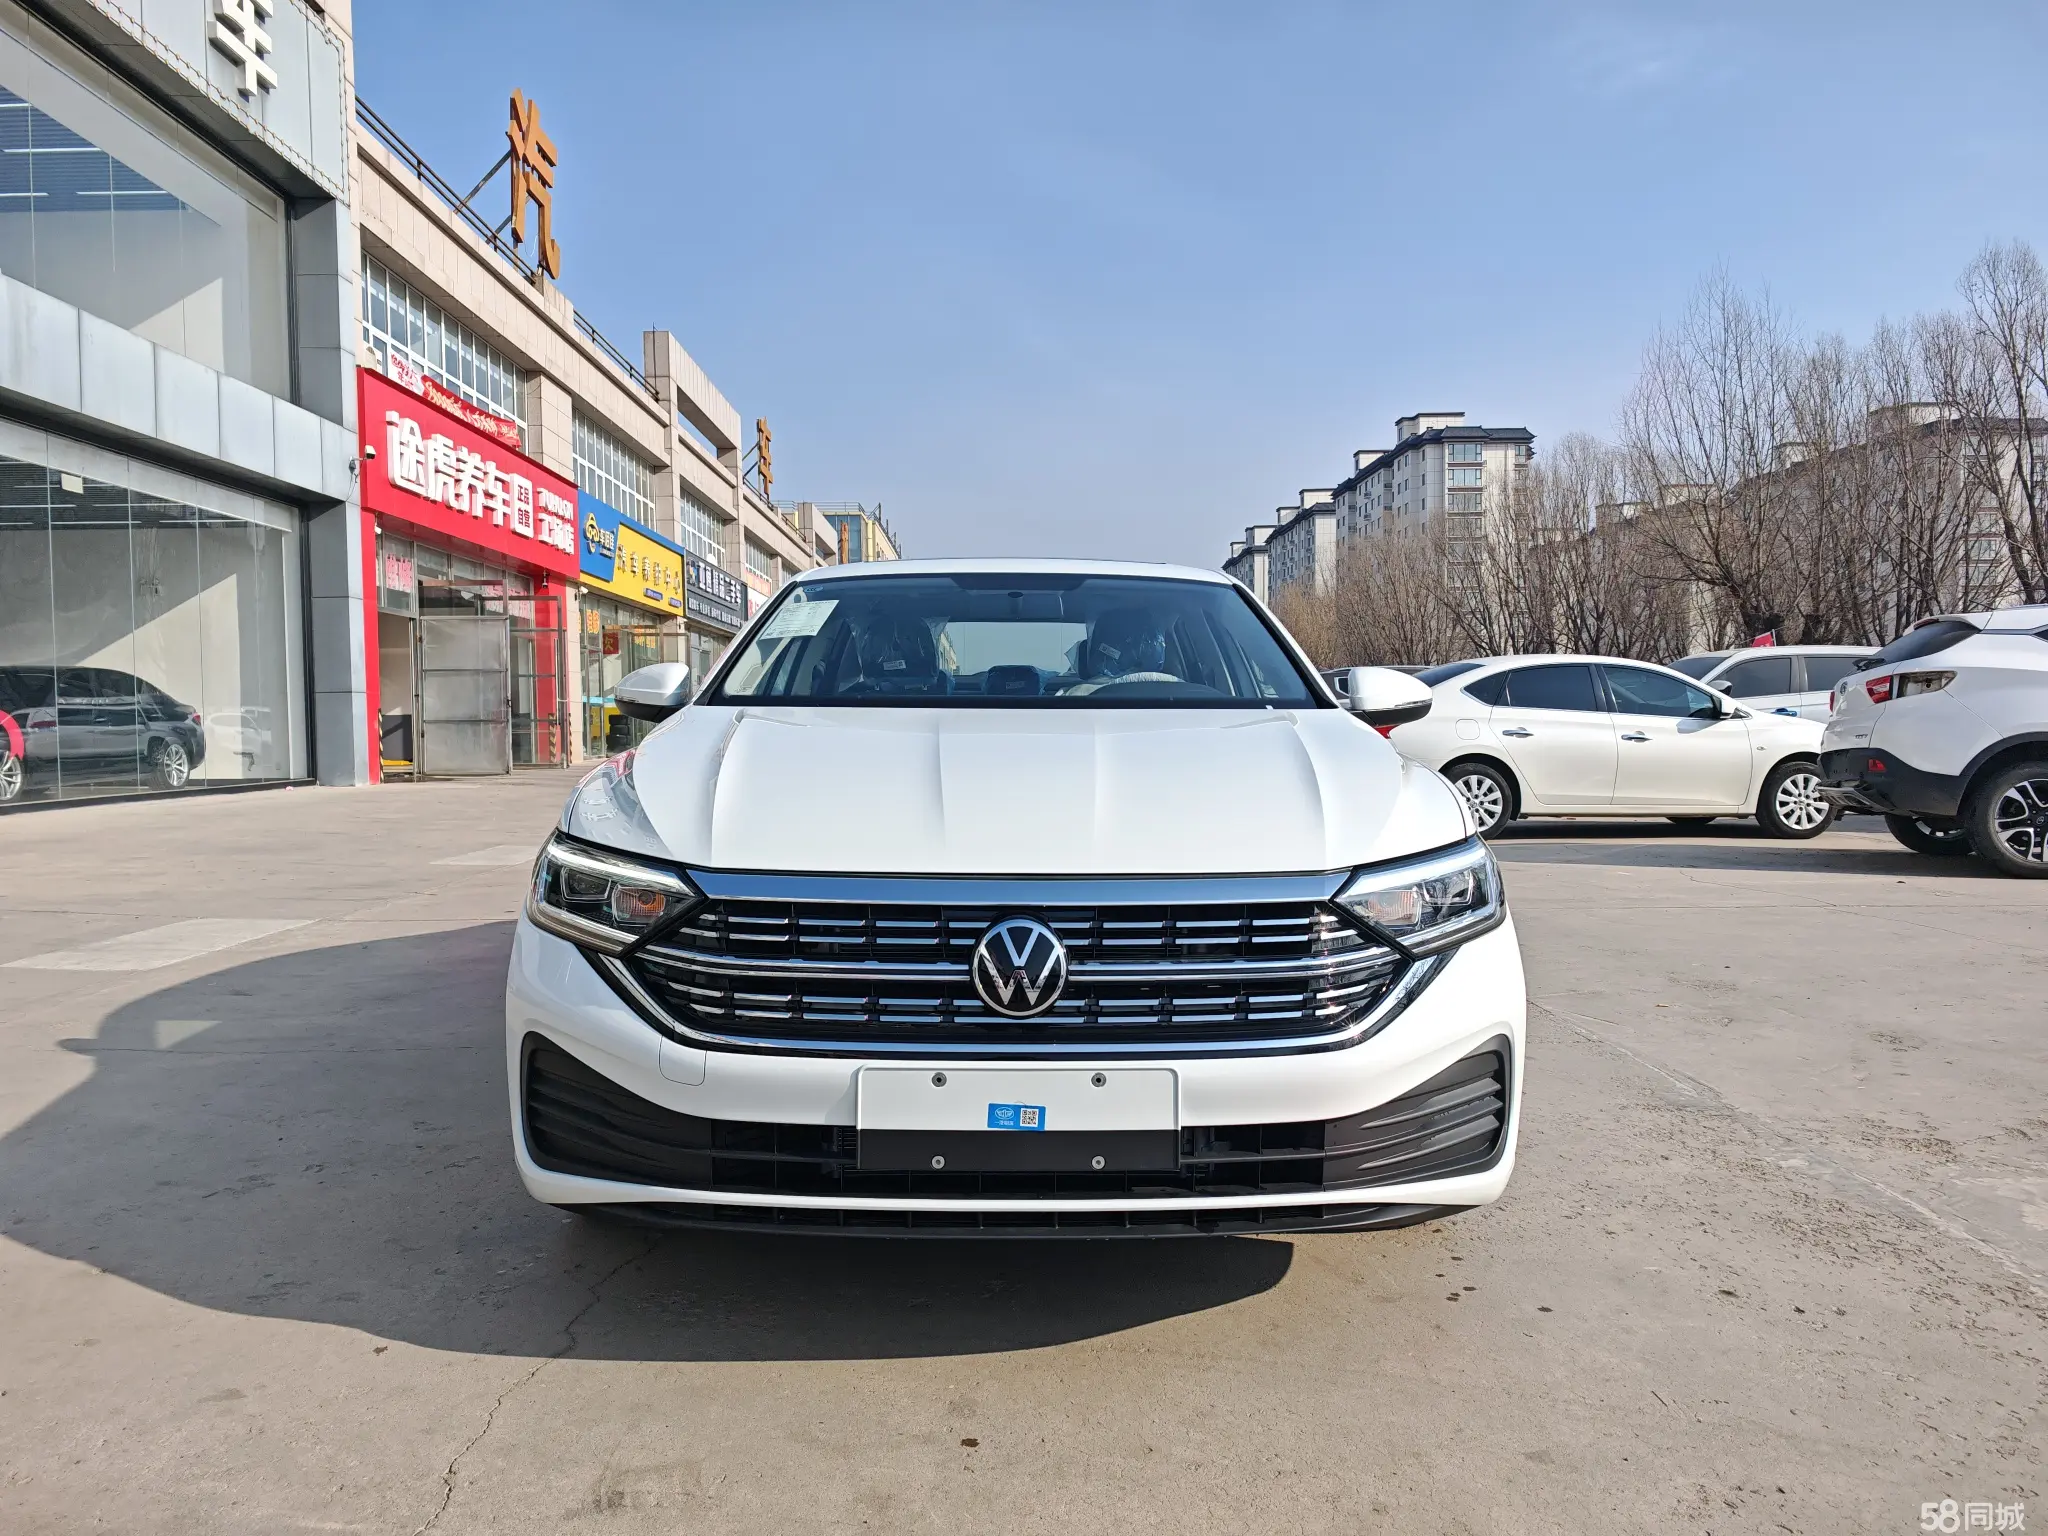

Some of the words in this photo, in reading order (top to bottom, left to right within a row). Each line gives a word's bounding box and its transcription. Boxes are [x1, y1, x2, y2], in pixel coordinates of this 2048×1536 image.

[506, 87, 560, 280] 汽
[386, 411, 511, 527] 途虎养车
[517, 484, 530, 505] 正品
